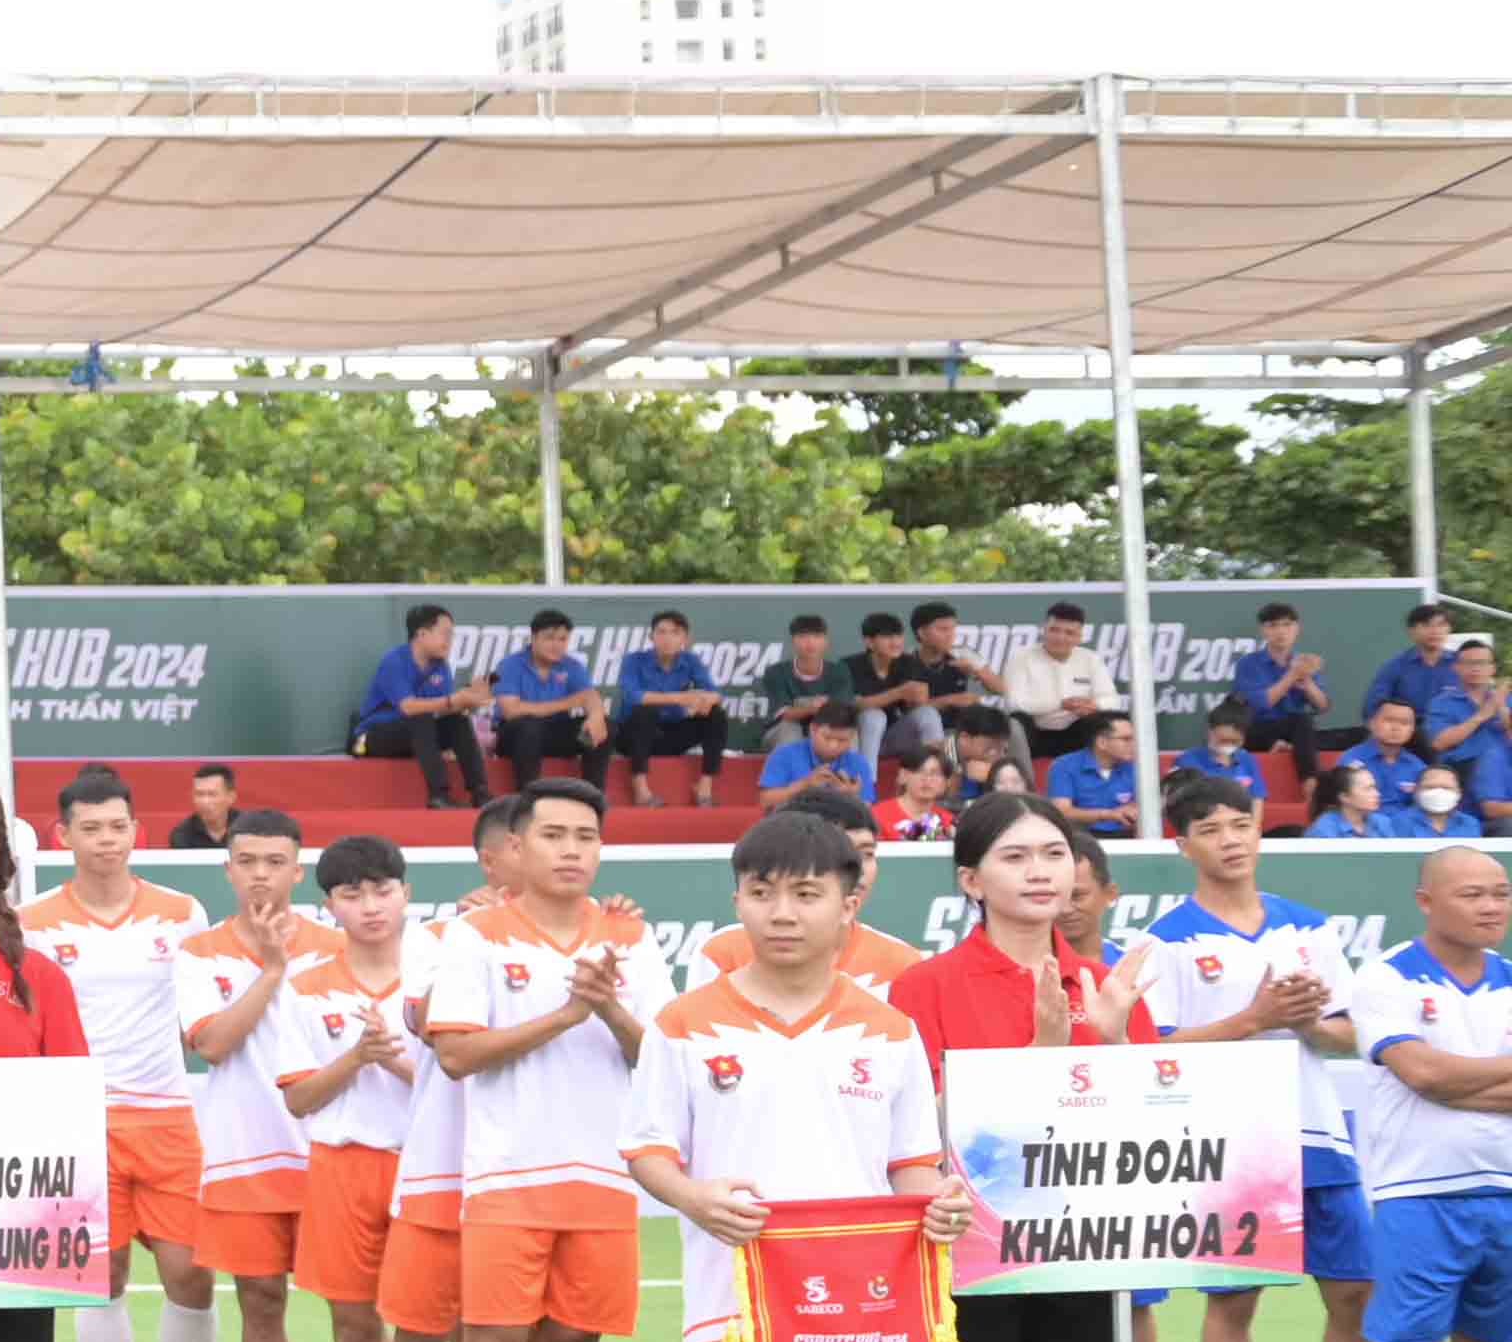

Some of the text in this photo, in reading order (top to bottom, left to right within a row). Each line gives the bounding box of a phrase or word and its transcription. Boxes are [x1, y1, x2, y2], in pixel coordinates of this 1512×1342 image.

[107, 643, 208, 689] 2024
[131, 693, 199, 725] VIỆT
[1057, 1096, 1107, 1108] SABECO
[29, 1156, 76, 1211] MẠI
[1021, 1126, 1226, 1188] TỈNH ĐOÀN
[57, 1215, 91, 1282] BỘ
[1000, 1200, 1260, 1264] KHÁNH HÒA 2
